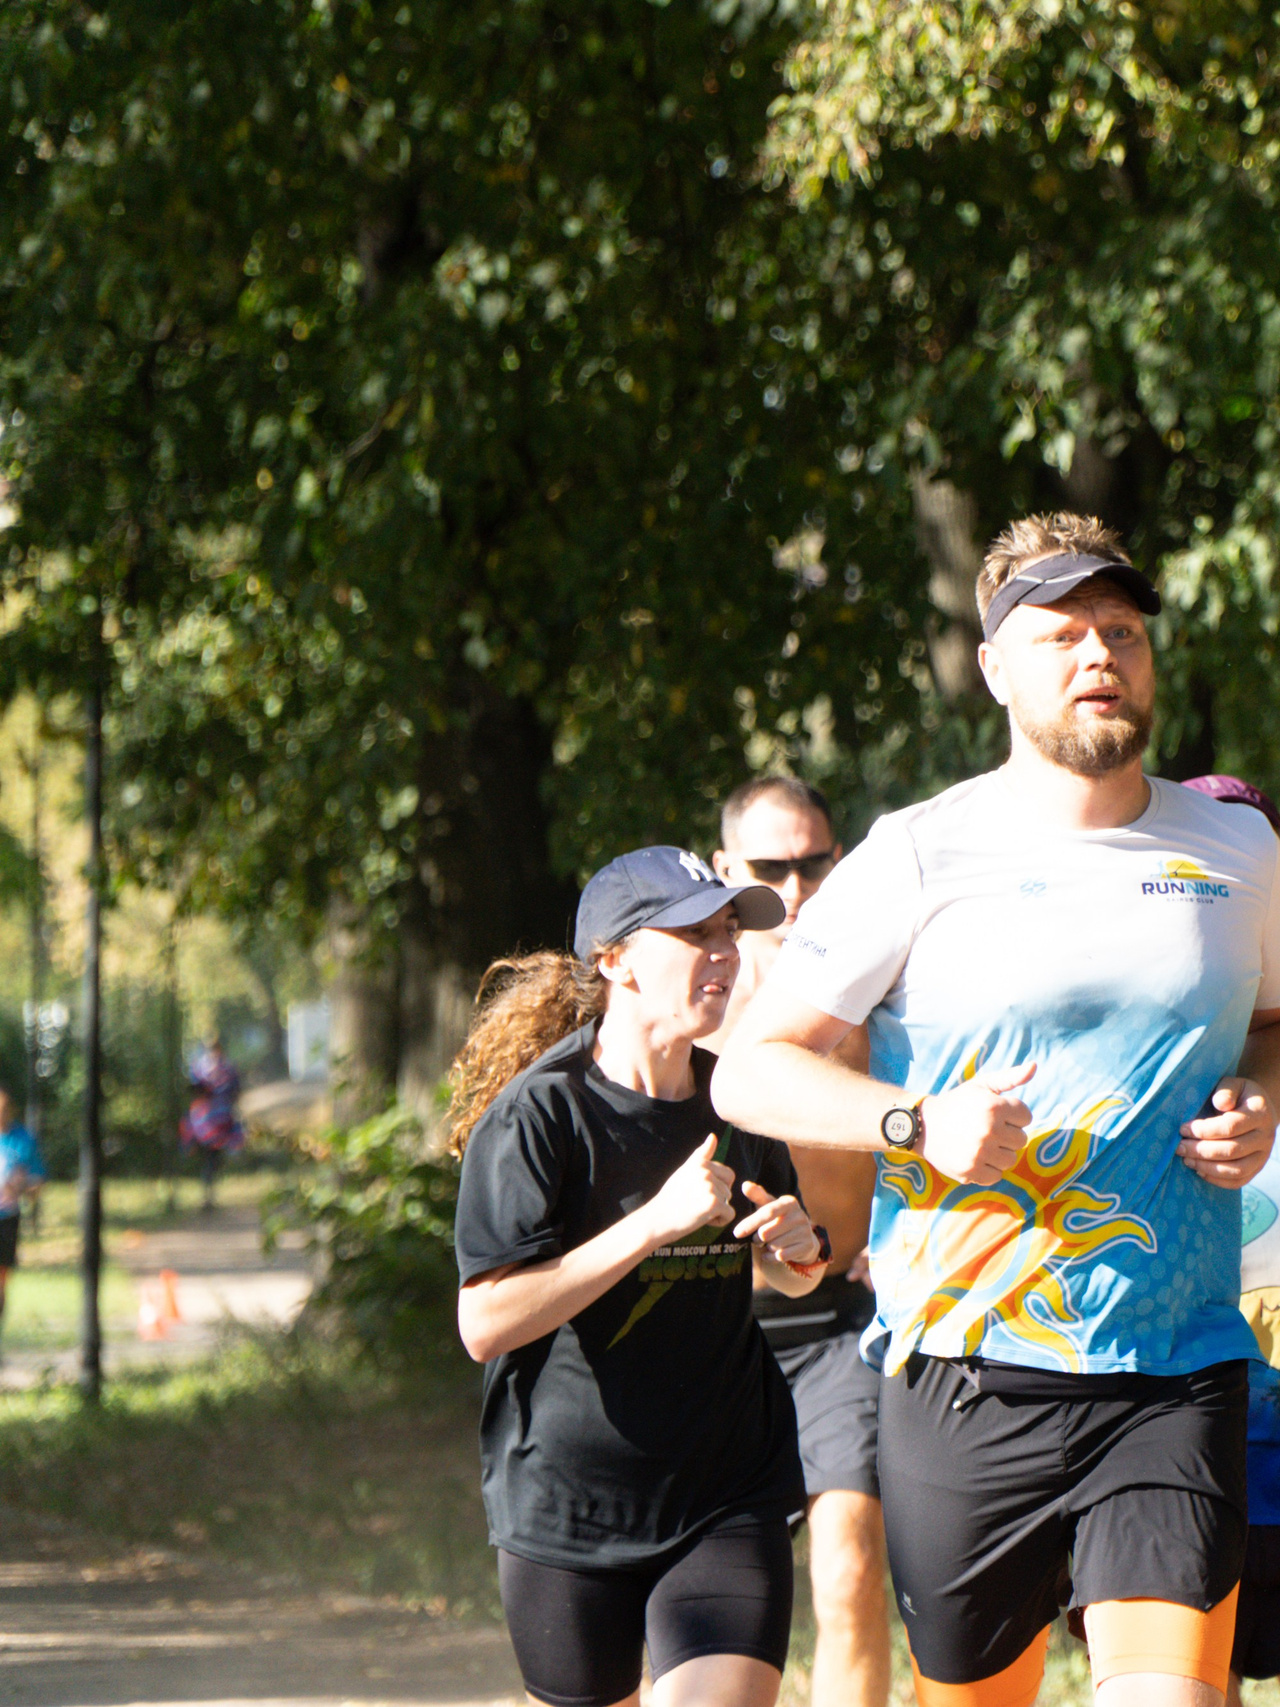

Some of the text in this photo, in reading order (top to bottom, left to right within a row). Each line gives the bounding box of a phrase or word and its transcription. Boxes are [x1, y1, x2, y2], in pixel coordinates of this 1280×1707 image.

[1141, 881, 1230, 898] RUNNING
[1196, 897, 1214, 905] CLUB
[673, 1245, 708, 1257] MOSCOW
[709, 1244, 722, 1255] 10K
